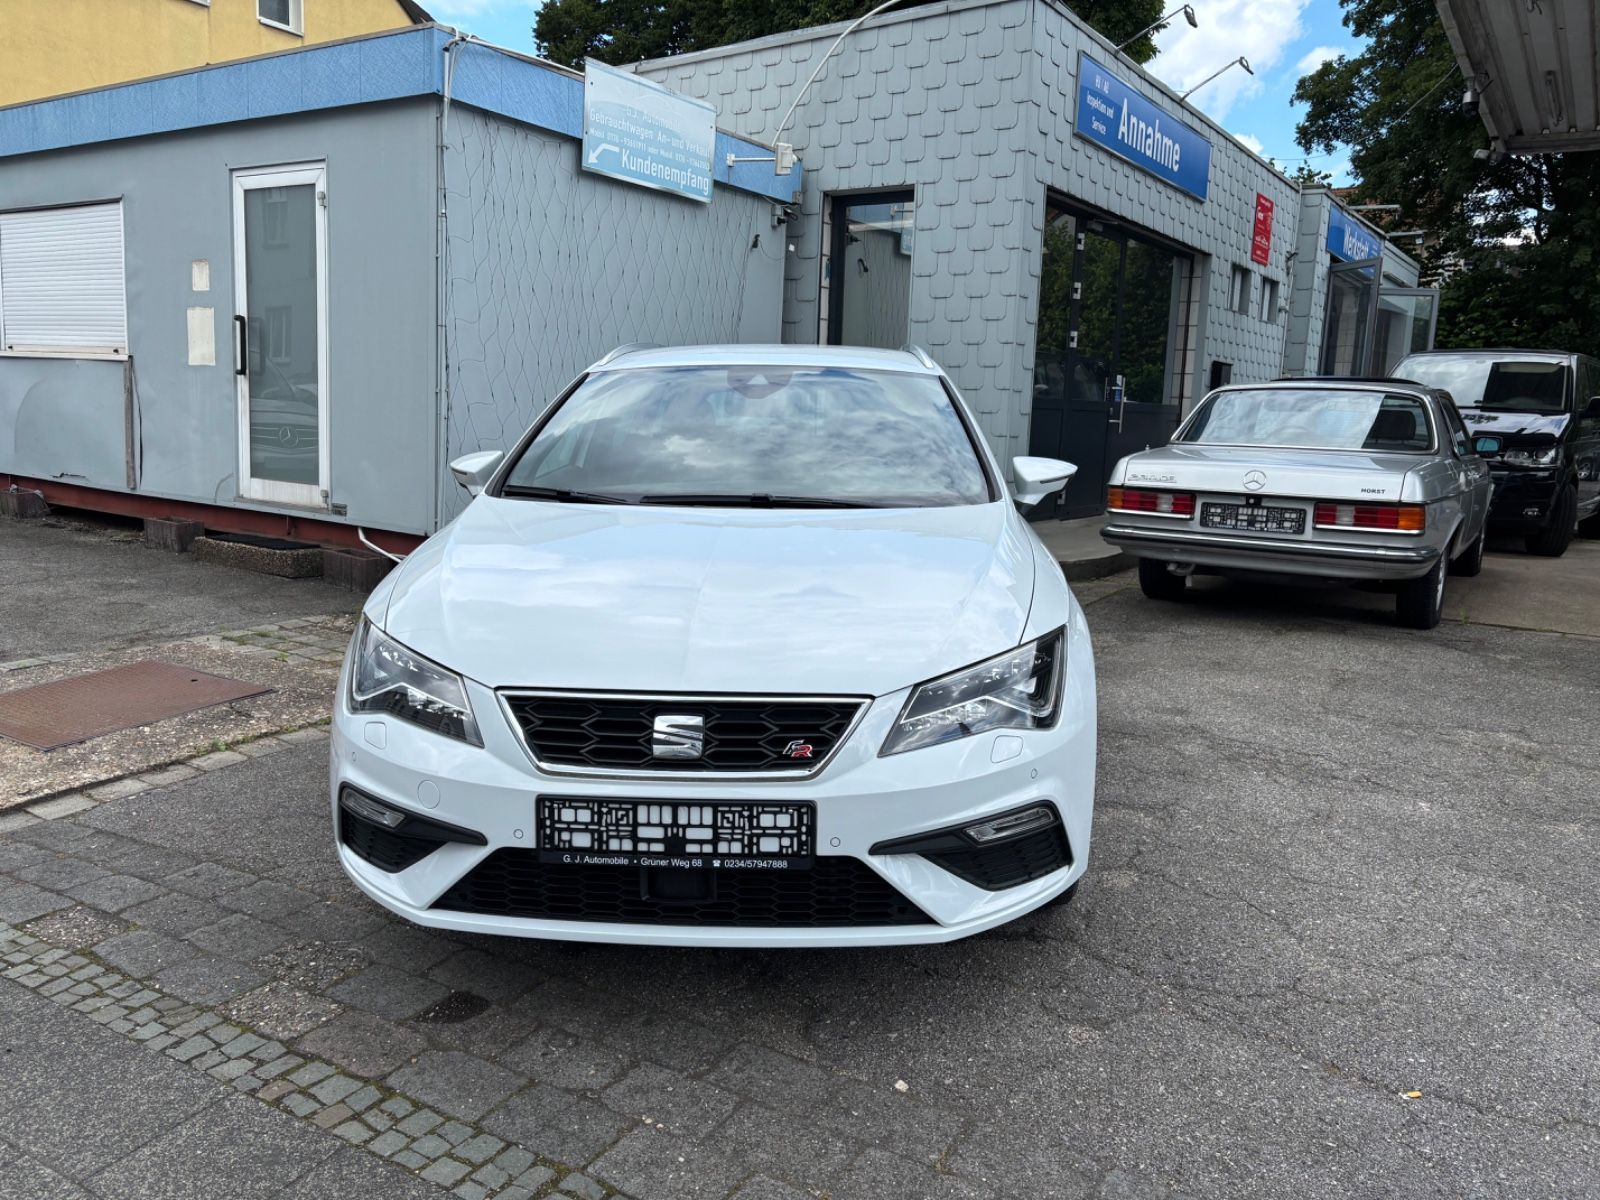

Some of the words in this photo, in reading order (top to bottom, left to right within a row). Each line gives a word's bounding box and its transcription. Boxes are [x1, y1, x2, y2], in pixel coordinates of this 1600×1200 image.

[590, 108, 653, 139] Gebrauchtwagen
[1118, 97, 1180, 172] Annahme
[621, 148, 709, 195] Kundenempfang
[583, 855, 629, 865] Automobile
[670, 858, 690, 869] Weg
[691, 859, 703, 867] 68
